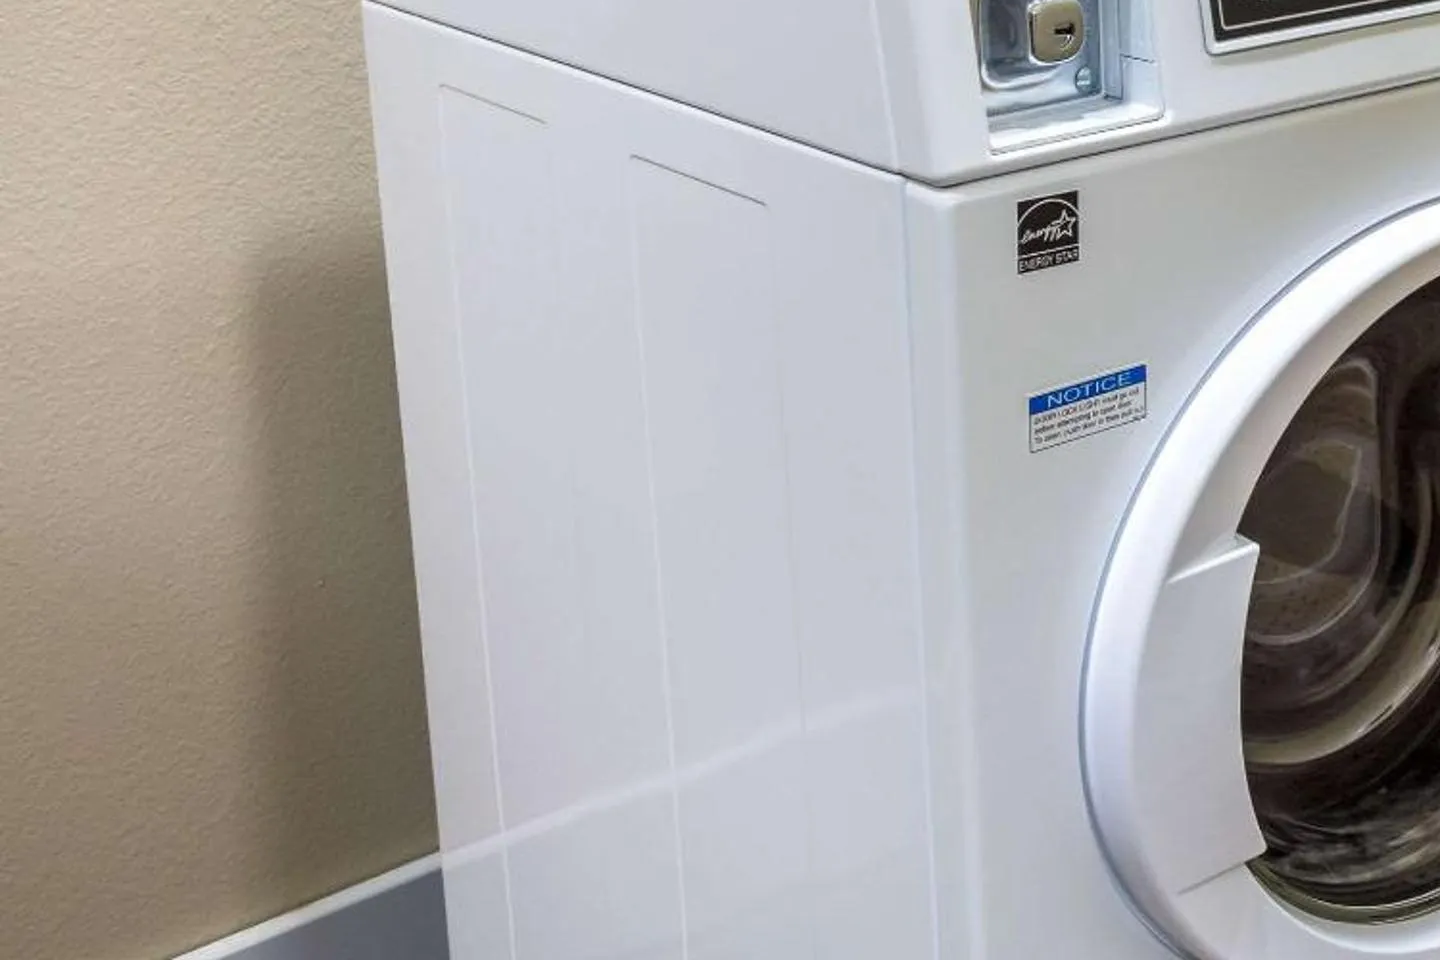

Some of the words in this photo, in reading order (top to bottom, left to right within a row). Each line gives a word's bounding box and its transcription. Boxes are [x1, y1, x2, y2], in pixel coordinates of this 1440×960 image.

[1019, 255, 1054, 271] ENERGY
[1055, 249, 1079, 264] STAR
[1047, 372, 1132, 408] NOTICE
